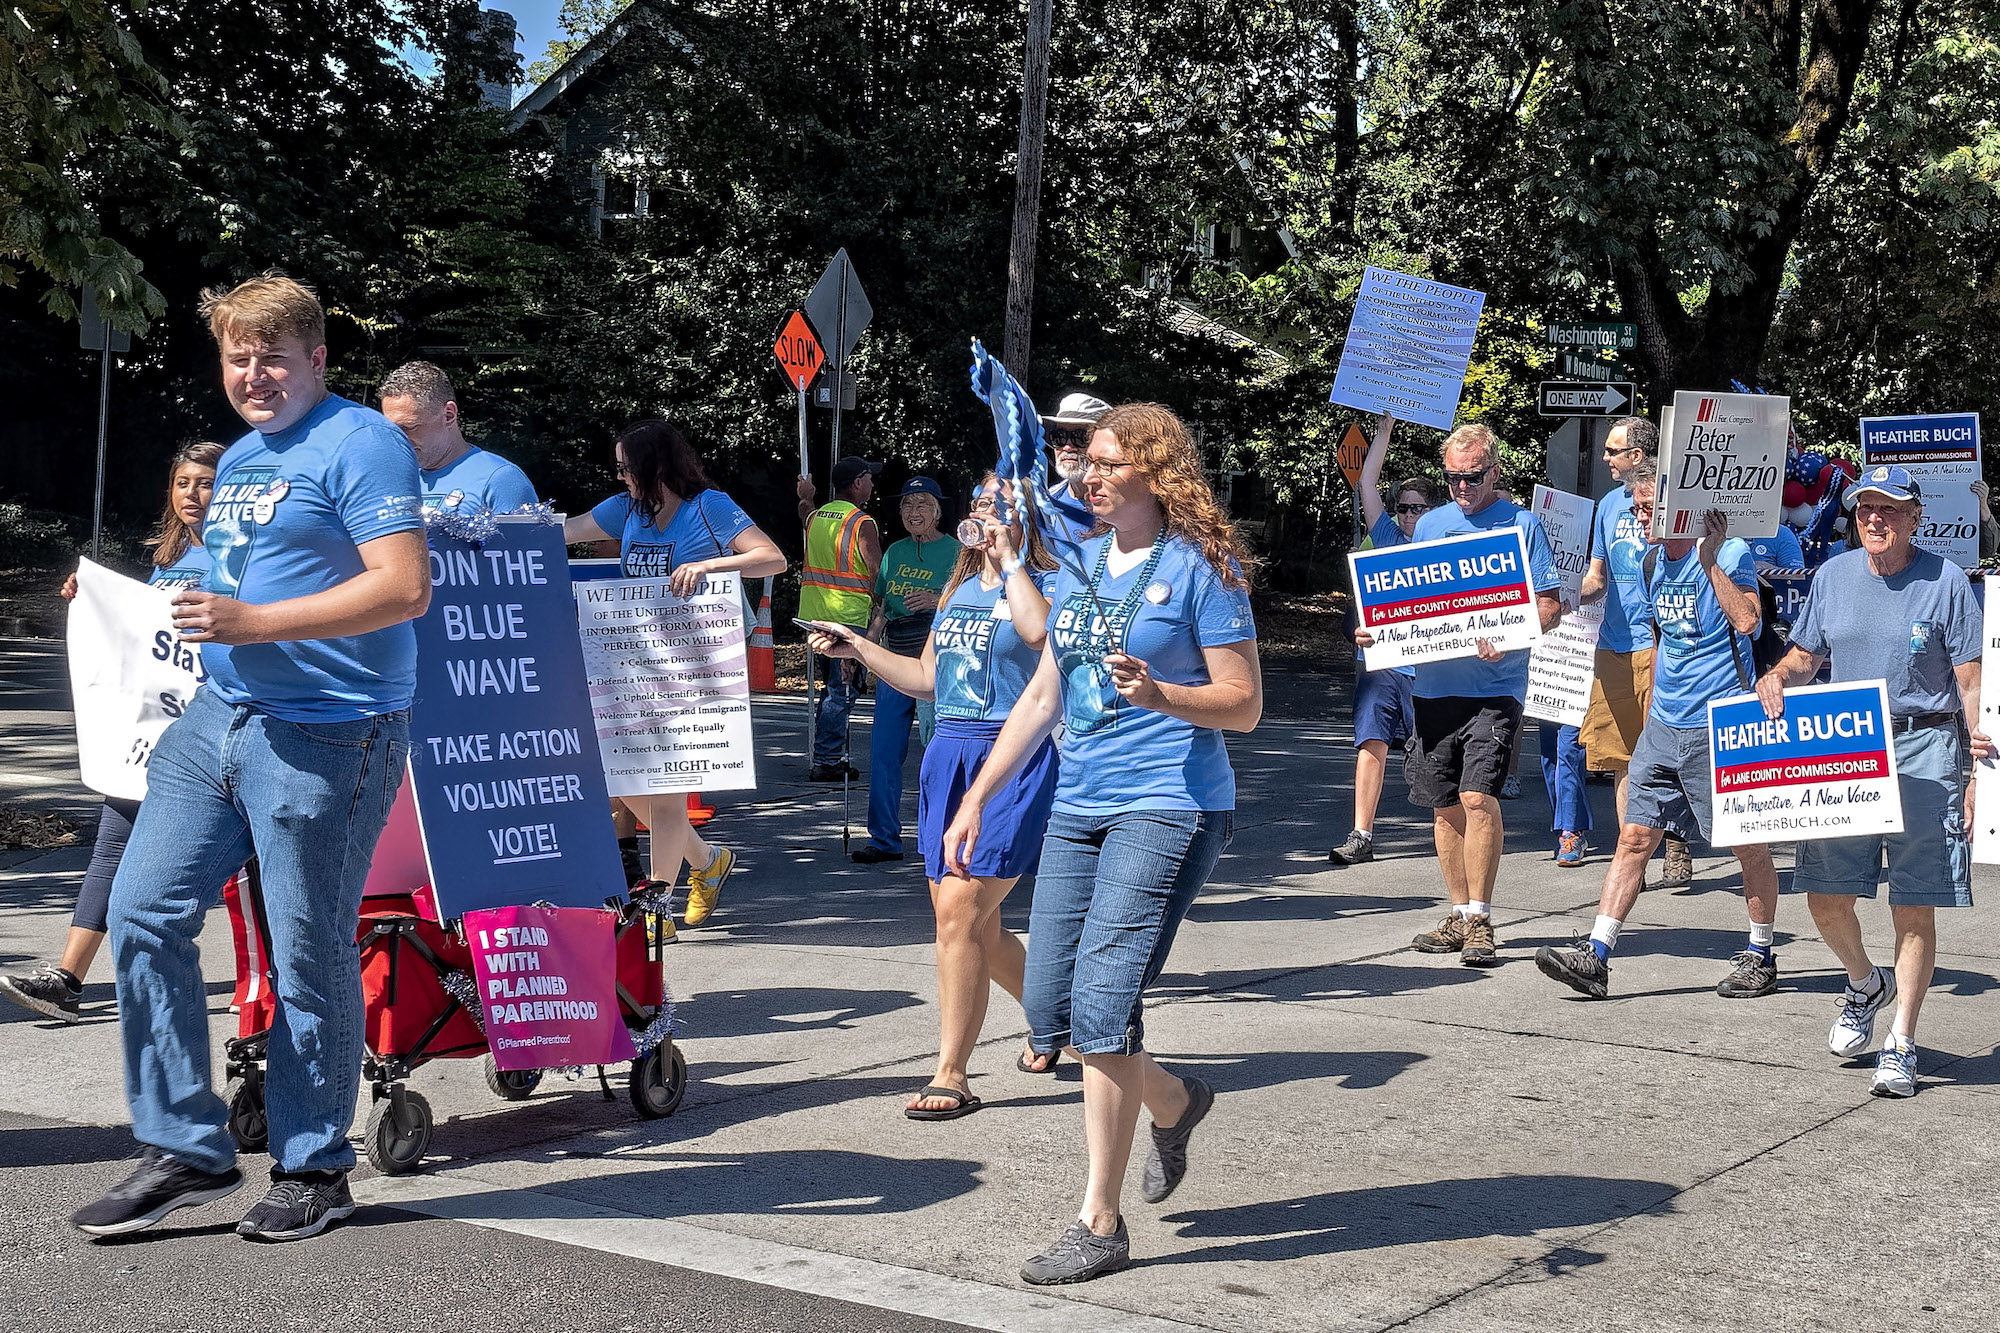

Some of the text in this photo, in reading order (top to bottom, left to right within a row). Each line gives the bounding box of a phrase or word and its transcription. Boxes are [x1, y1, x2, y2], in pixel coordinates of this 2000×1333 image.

[1371, 272, 1479, 306] WE THE PEOPLE
[1374, 298, 1474, 326] ORDER FORM MORE
[1402, 292, 1470, 316] UNITED STATES,
[1371, 308, 1436, 328] PERFECT UNION
[1385, 322, 1446, 343] Celebrate Diversity
[1548, 325, 1632, 346] Washington St
[781, 335, 816, 368] SLOW
[1373, 344, 1398, 354] Uphold
[1620, 338, 1634, 348] 900
[1565, 355, 1611, 382] W Broadway
[1361, 376, 1384, 386] Protect
[1418, 377, 1442, 389] Equally
[1348, 386, 1374, 398] Exercise
[1387, 394, 1424, 410] RIGHT
[1550, 392, 1605, 405] ONE WAY
[1728, 415, 1754, 426] Congress
[1686, 424, 1736, 452] Peter
[1868, 428, 1972, 445] HEATHER BUCH
[1870, 452, 1972, 462] for LANE COUNTY COMMISSIONER
[226, 472, 272, 484] JOIN THE
[1678, 453, 1778, 490] DeFazio
[1940, 463, 1972, 474] New Voice
[214, 484, 266, 503] BLUE
[1712, 492, 1753, 504] Democrat
[206, 503, 255, 522] WAVE
[1910, 515, 1978, 540] Fazio
[632, 546, 670, 554] JOIN THE
[1909, 538, 1952, 546] Democrat
[626, 552, 669, 566] BLUE
[1552, 540, 1586, 574] Fazio
[428, 549, 548, 586] OIN THE
[626, 565, 668, 577] WAVE
[898, 564, 934, 580] Team
[1364, 562, 1455, 594] HEATHER
[1458, 551, 1517, 578] BUCH
[586, 579, 733, 603] WE THE POPLE
[1371, 590, 1522, 622] for LANE COUNTY COMMISSIONER
[1656, 594, 1696, 609] BLUE
[594, 602, 728, 621] OF THE UNITED STATES,
[949, 609, 974, 620] JOIN
[1657, 606, 1695, 620] WAVE
[443, 603, 528, 641] BLUE
[586, 618, 738, 637] IN ORDER TO FORM MORE
[937, 618, 994, 636] BLUE
[1376, 610, 1526, 644] A New Perspective, A New Voice
[603, 636, 723, 651] PERFECT UNION WILL:
[934, 632, 988, 651] WAVE
[1558, 632, 1576, 642] Right
[628, 654, 710, 667] Celebrate Diversity
[1571, 648, 1588, 657] Facts
[446, 658, 541, 697] WAVE
[596, 669, 744, 686] Defend Woman's Right Choose
[1538, 667, 1586, 684] People Equally
[624, 688, 720, 702] Uphold Scientific Facts
[1542, 681, 1586, 696] Environment
[1533, 694, 1568, 709] RIGHT
[600, 704, 747, 720] Welcome Refugees and Immigrants
[624, 723, 725, 736] Treat All People Equally
[1718, 710, 1875, 752] HEATHER BUCH
[426, 727, 582, 766] TAKE ACTION
[622, 740, 730, 754] Protect Our Environment
[610, 760, 744, 776] Exercise our RIGHT to vote!
[1720, 759, 1878, 788] for LANE COUNTY COMMISSIONER
[443, 774, 584, 812] VOLUNTEER
[1722, 784, 1882, 817] A New Perspective, A New Voice
[1740, 815, 1852, 834] HEATHERBUCH.COM
[488, 823, 559, 856] VOTE!
[479, 926, 549, 950] I STAND
[485, 951, 541, 974] WITH
[488, 976, 568, 1000] PLANNED
[491, 1000, 598, 1025] PARENTHOOD
[506, 1034, 571, 1049] Planned Parenthood
